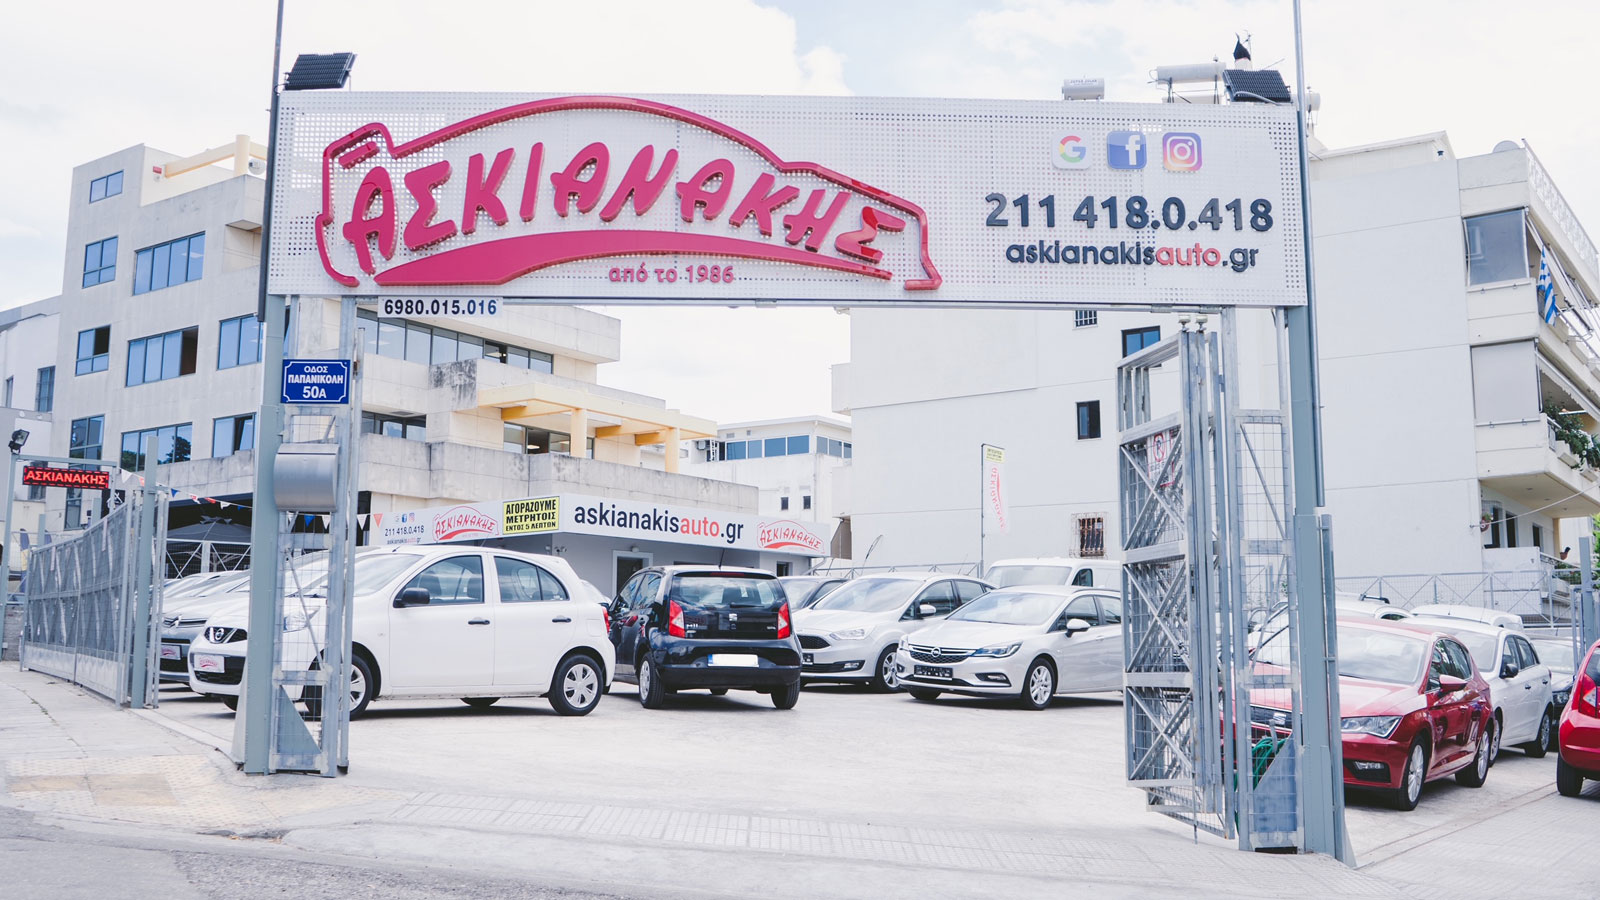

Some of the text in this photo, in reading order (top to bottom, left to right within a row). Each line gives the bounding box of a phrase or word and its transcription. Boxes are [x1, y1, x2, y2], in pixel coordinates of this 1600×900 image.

[342, 141, 907, 276] ΑΣΚΙΑΝΑΚΗΣ
[984, 192, 1274, 232] 211 418.0.418
[1005, 240, 1260, 273] askianakisauto.gr
[608, 262, 735, 284] από το 1986
[383, 299, 498, 316] 6980.015.016
[304, 365, 329, 373] ΟΔΟΣ
[287, 374, 344, 384] ΠΑΠΑΝΙΚΟΛΗ
[25, 470, 106, 485] ΑΣΚΙΑΝΑΚΗΣ
[505, 499, 557, 515] ΑΓΟΡΑΖΟΥΜΕ
[434, 513, 496, 539] ΑΣΚΙΑΝΑΚΗΣ
[506, 511, 556, 524] ΜΕΤΡΗΤΟΙΣ
[573, 502, 744, 544] askianakisauto.gr
[384, 524, 425, 537] 211 418.0.418
[760, 527, 821, 547] ΑΣΚΙΑΝΑΚΗΣ
